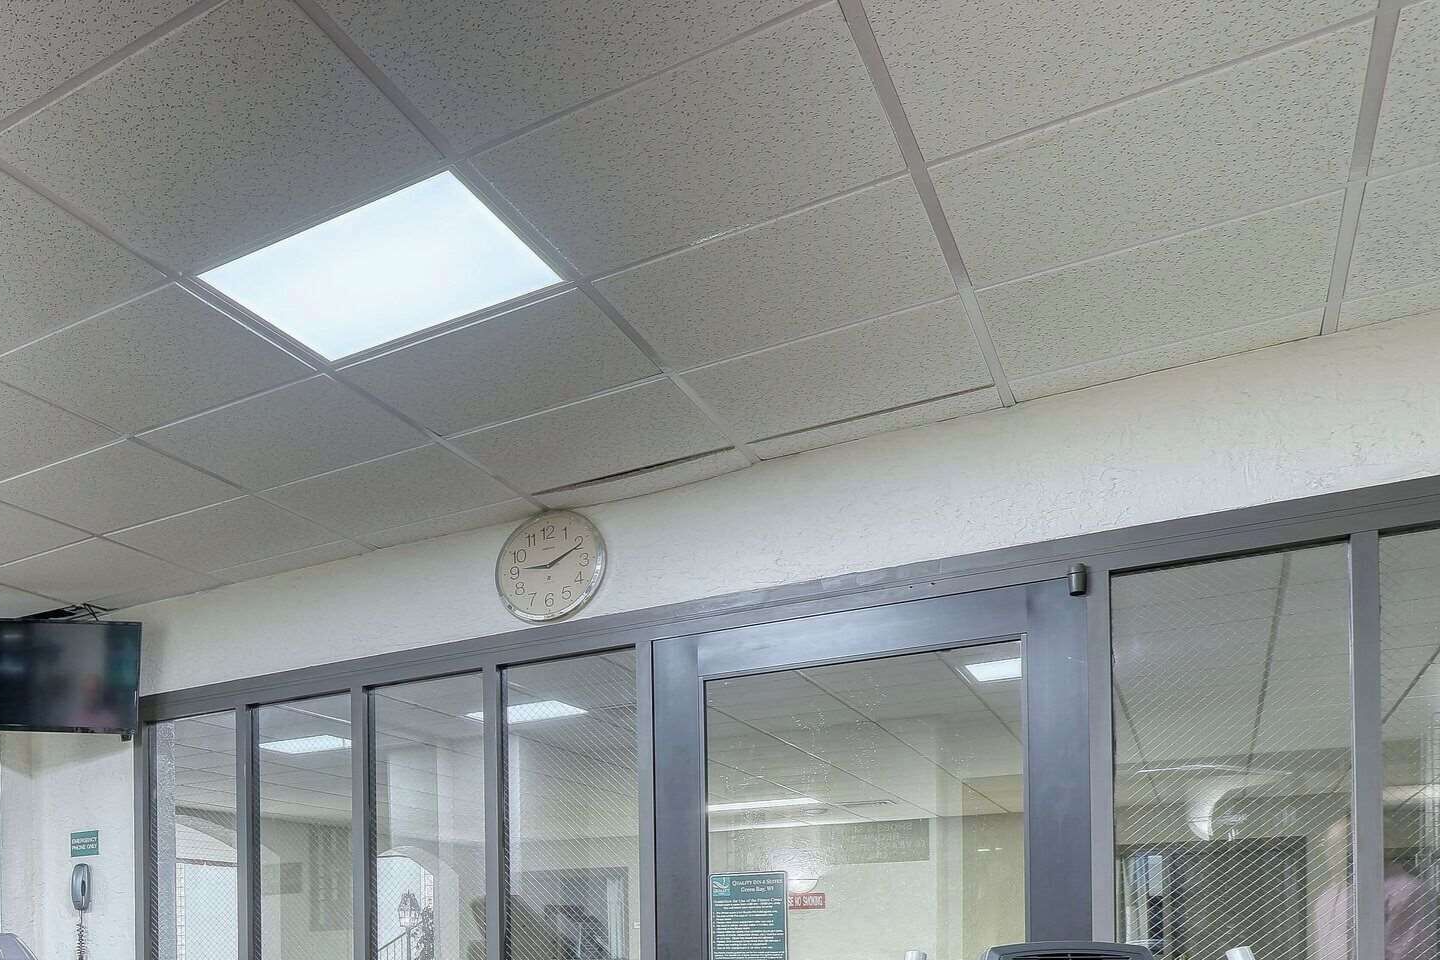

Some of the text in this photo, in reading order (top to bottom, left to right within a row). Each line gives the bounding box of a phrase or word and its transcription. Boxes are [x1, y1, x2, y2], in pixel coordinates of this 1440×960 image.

[527, 533, 536, 547] 11
[540, 525, 555, 541] 12
[562, 527, 568, 540] 1
[574, 535, 584, 551] 2
[512, 549, 527, 564] 10
[579, 552, 590, 567] 3
[509, 565, 520, 580] 9
[574, 570, 584, 584] 4
[514, 581, 525, 596] 8
[561, 585, 572, 600] 5
[527, 592, 537, 607] 7
[544, 592, 555, 608] 6
